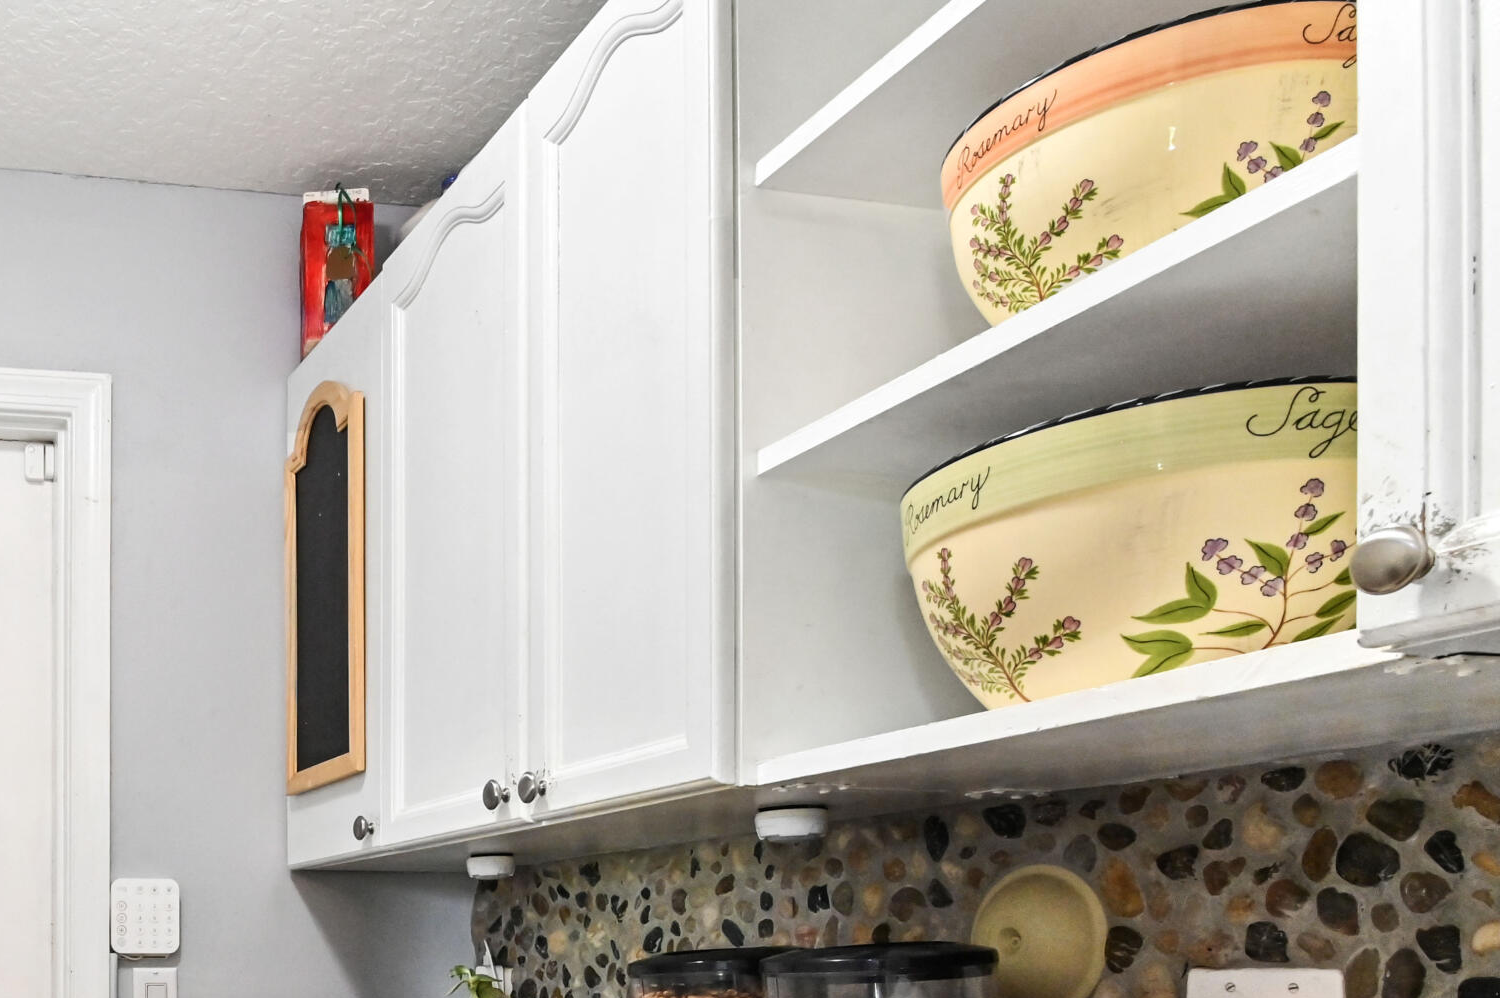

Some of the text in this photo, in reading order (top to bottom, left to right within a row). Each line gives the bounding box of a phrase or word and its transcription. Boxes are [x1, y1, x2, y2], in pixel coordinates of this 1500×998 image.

[1302, 3, 1357, 69] Sa
[957, 89, 1057, 190] Rosemary
[905, 466, 991, 547] Rosemary
